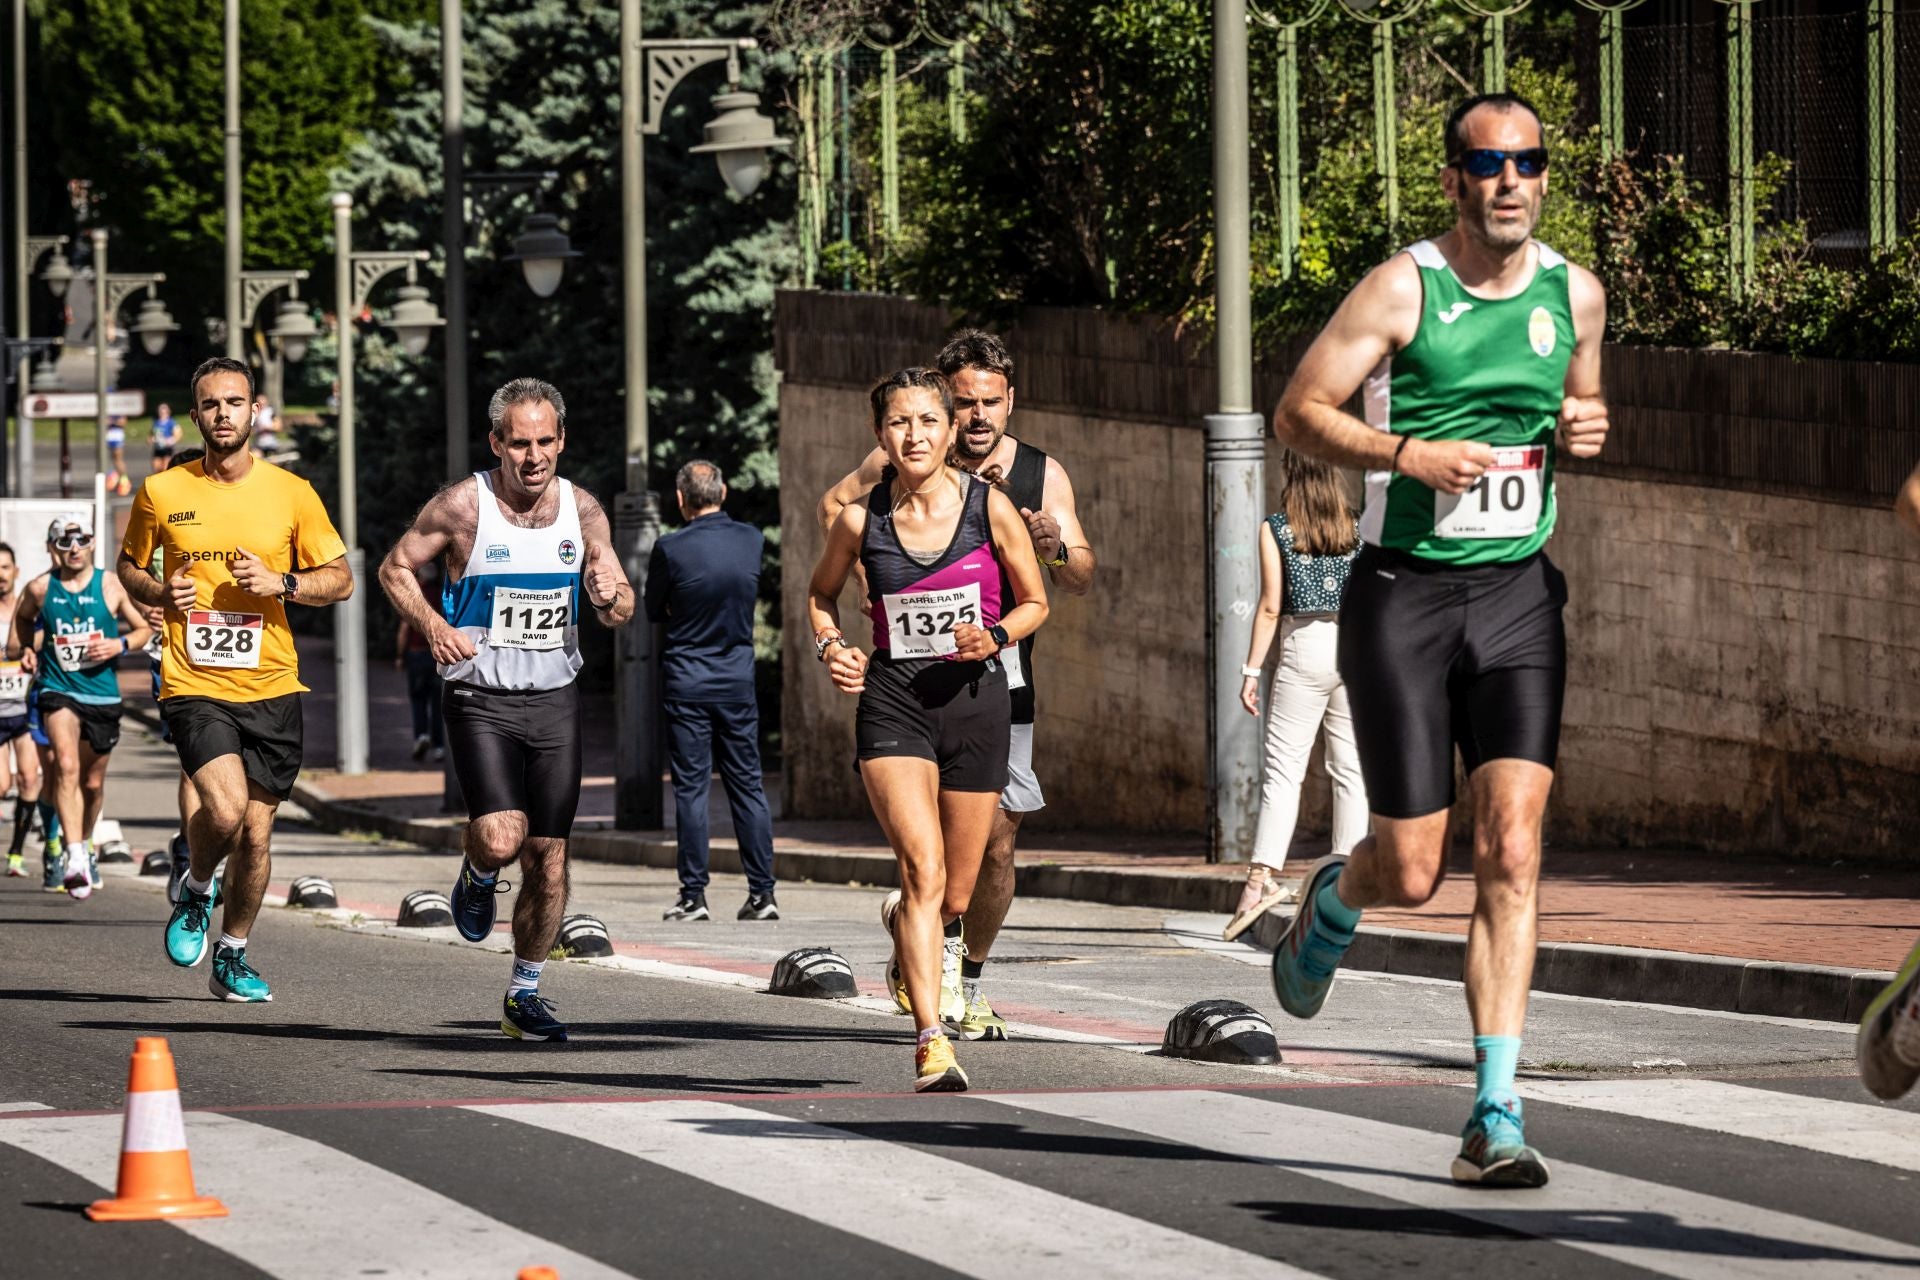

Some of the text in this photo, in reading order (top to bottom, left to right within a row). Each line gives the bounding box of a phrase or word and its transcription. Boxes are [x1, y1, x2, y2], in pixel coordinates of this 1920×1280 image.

[1468, 475, 1525, 512] 10
[167, 511, 196, 525] ASELAN
[182, 551, 244, 561] asenru
[509, 592, 553, 600] CARRERA
[900, 595, 951, 605] CARRERA
[499, 606, 569, 630] 1122
[895, 603, 976, 637] 1325
[194, 626, 254, 653] 328
[61, 645, 87, 661] 37
